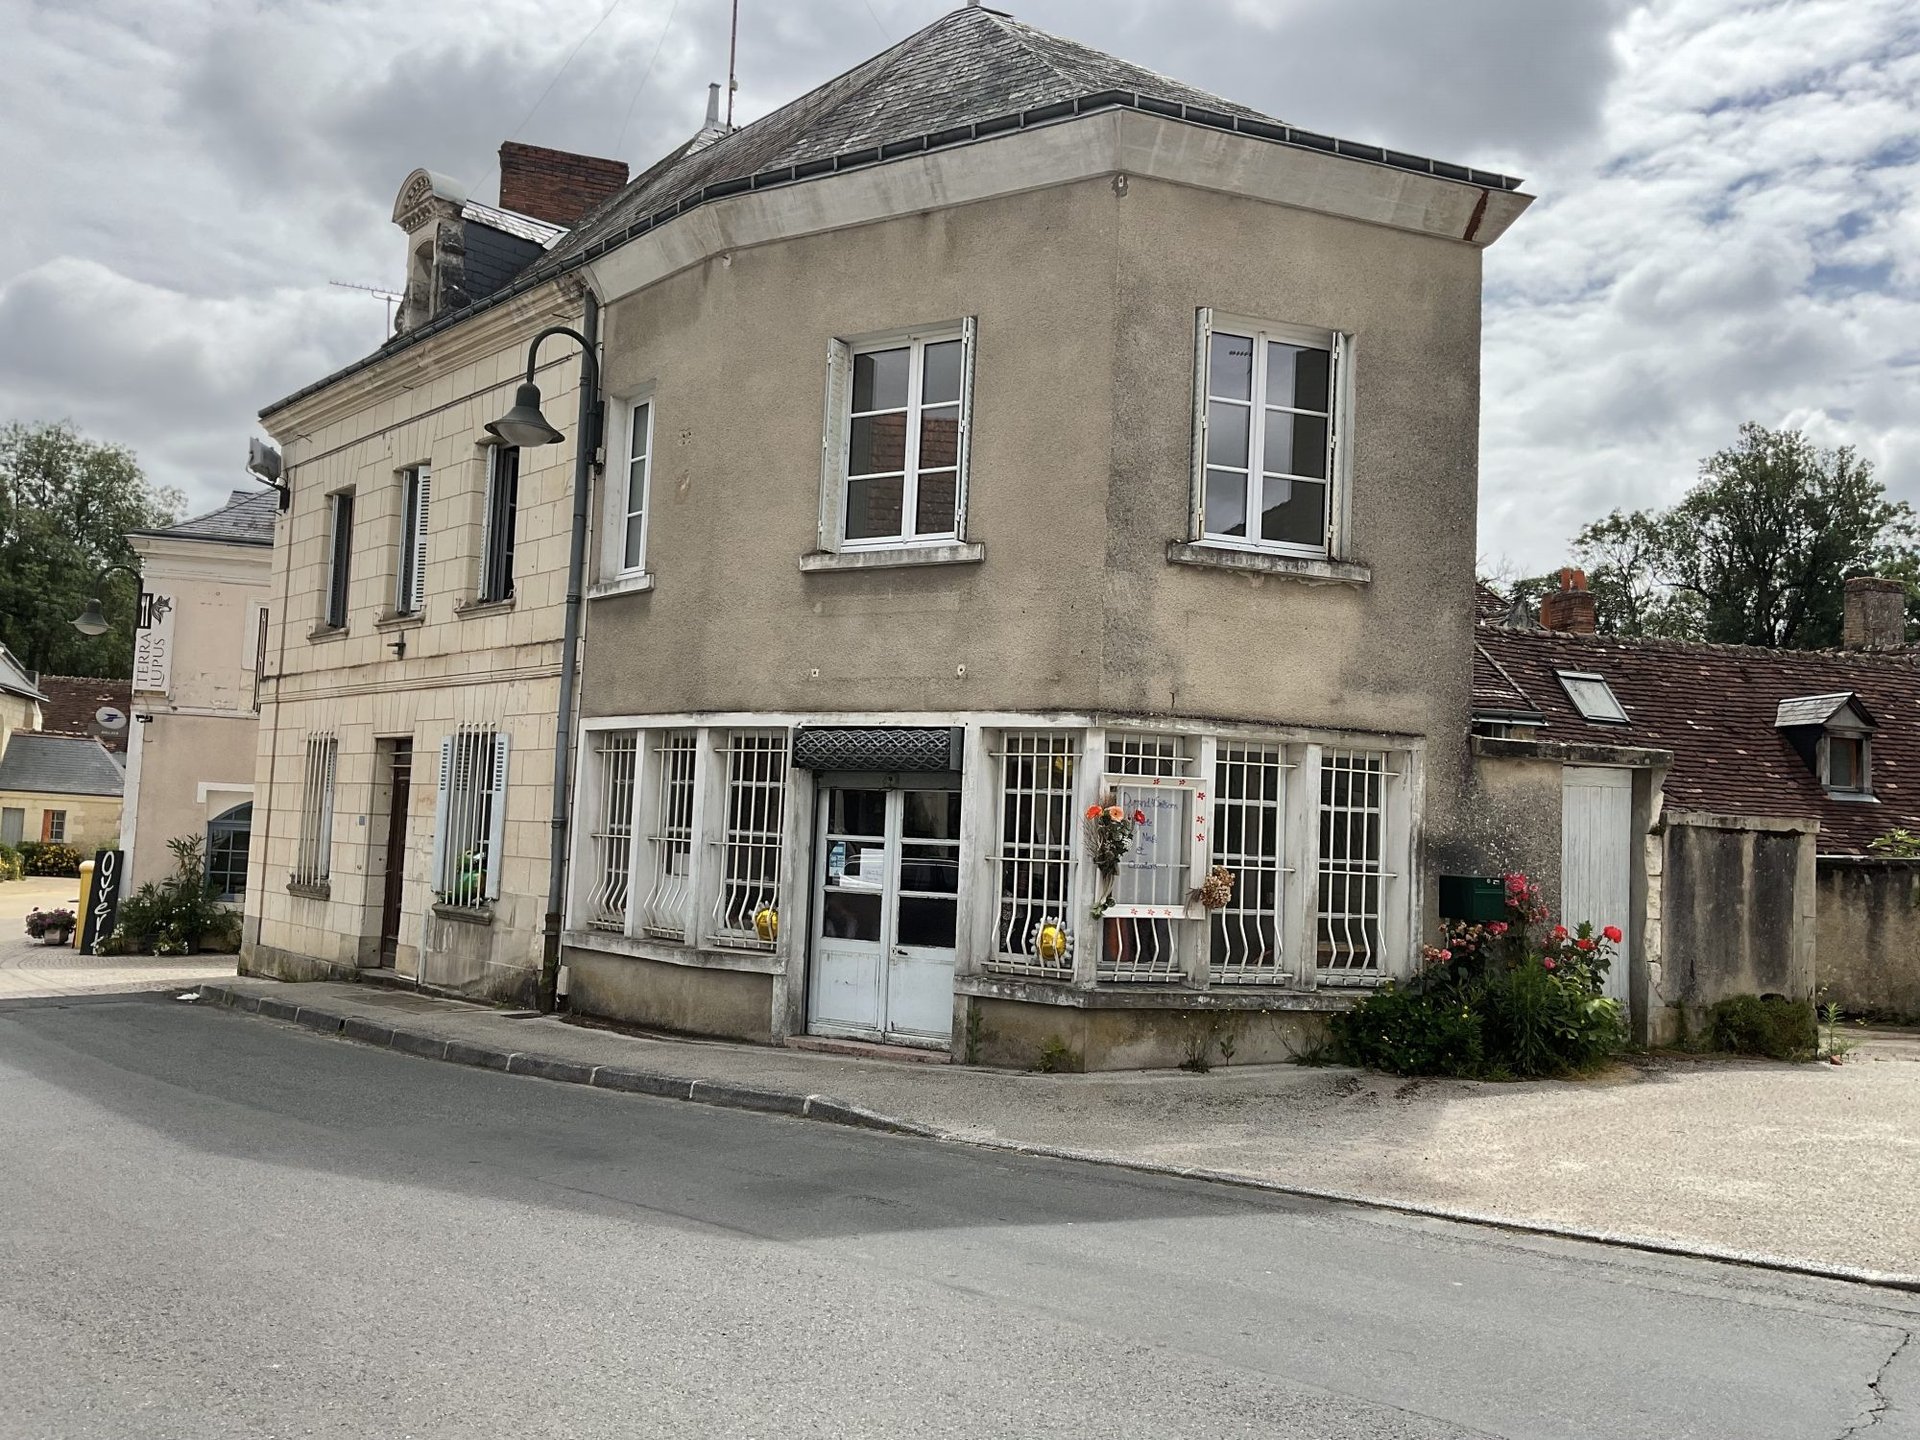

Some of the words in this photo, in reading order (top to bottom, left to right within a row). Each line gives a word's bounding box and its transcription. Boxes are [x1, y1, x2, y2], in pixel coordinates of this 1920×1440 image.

[136, 632, 151, 683] TERRA
[151, 638, 165, 687] LUPUS
[91, 851, 114, 954] Ouvert
